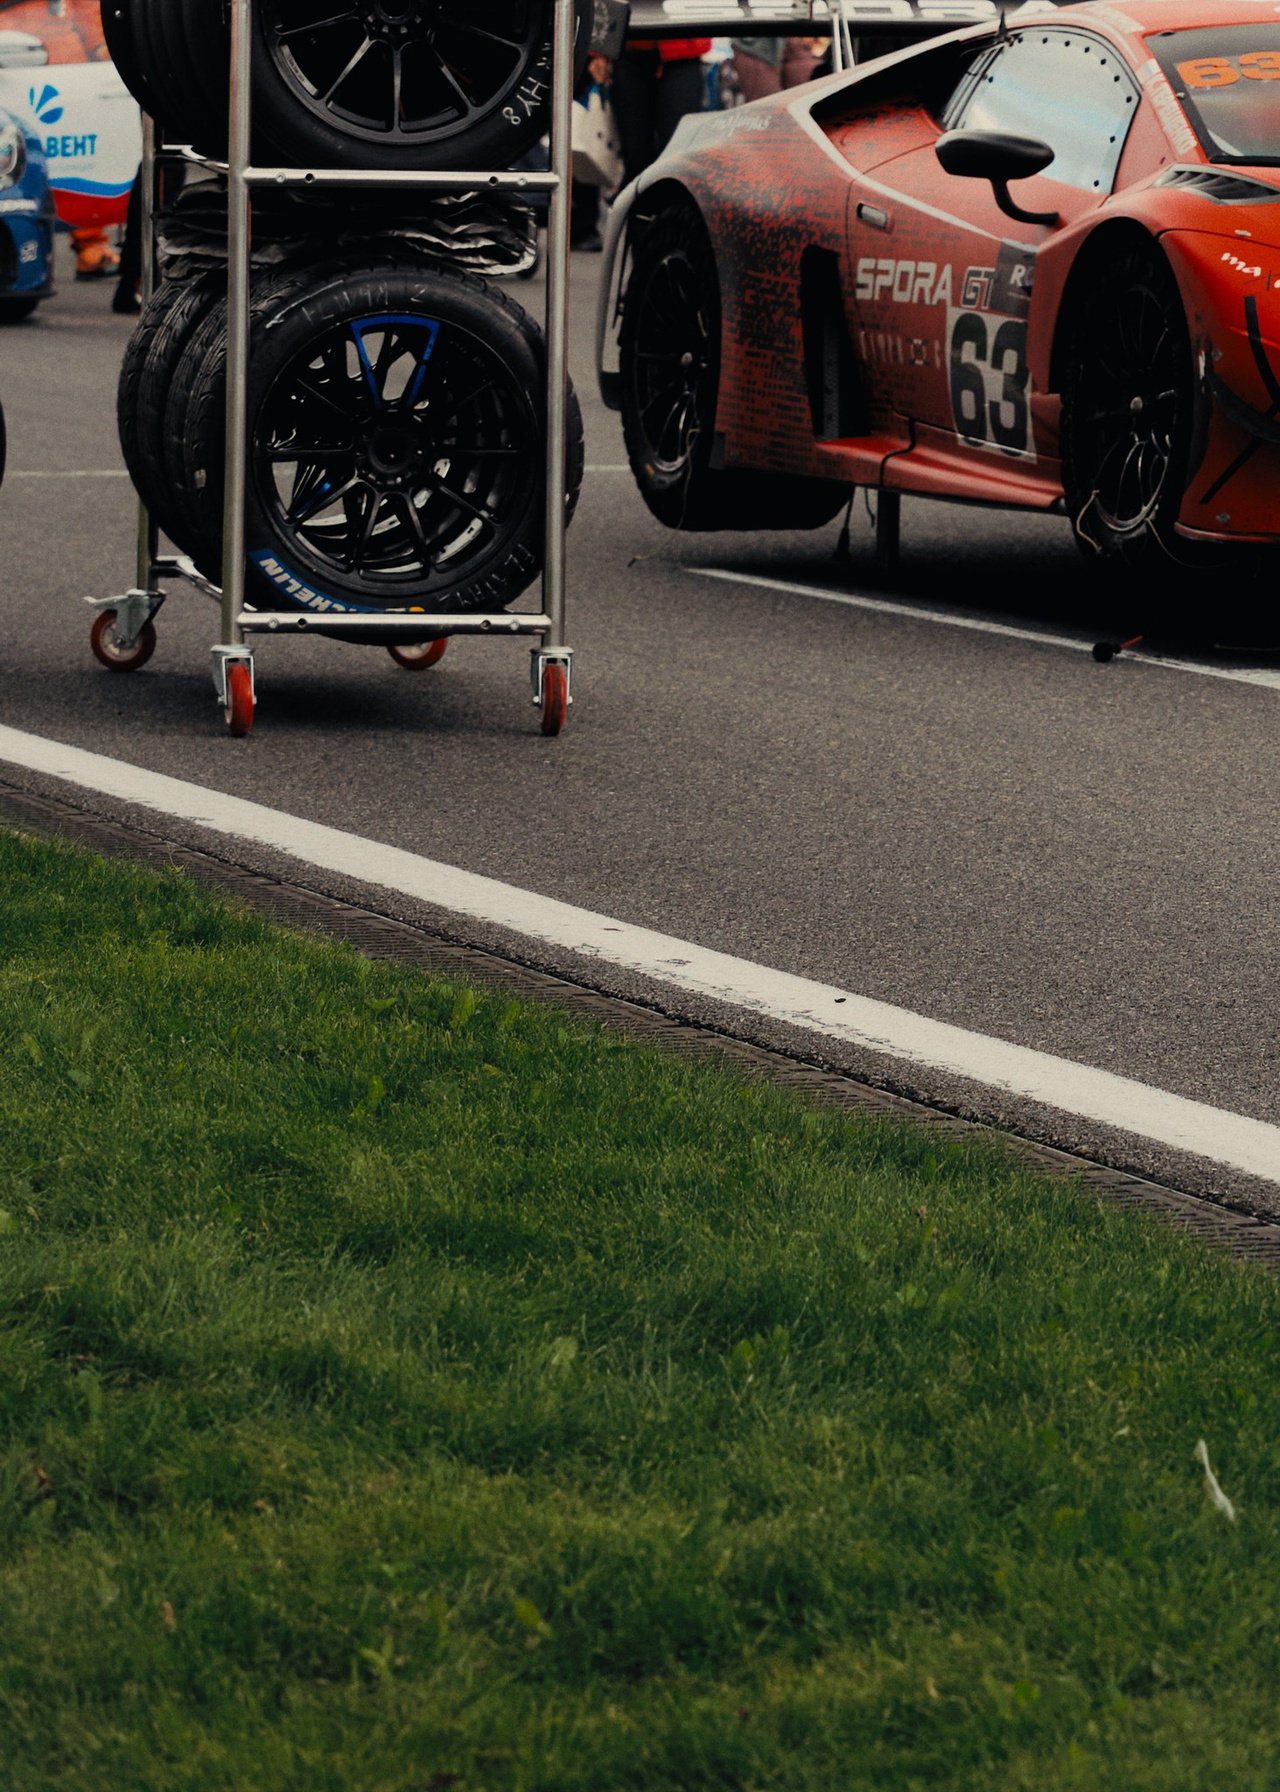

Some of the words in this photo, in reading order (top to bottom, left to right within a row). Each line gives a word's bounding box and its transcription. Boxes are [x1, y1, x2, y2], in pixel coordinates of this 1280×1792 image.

[856, 258, 952, 305] SPORA
[961, 266, 996, 310] GT
[951, 312, 1030, 457] 63
[259, 558, 358, 612] CHELIN
